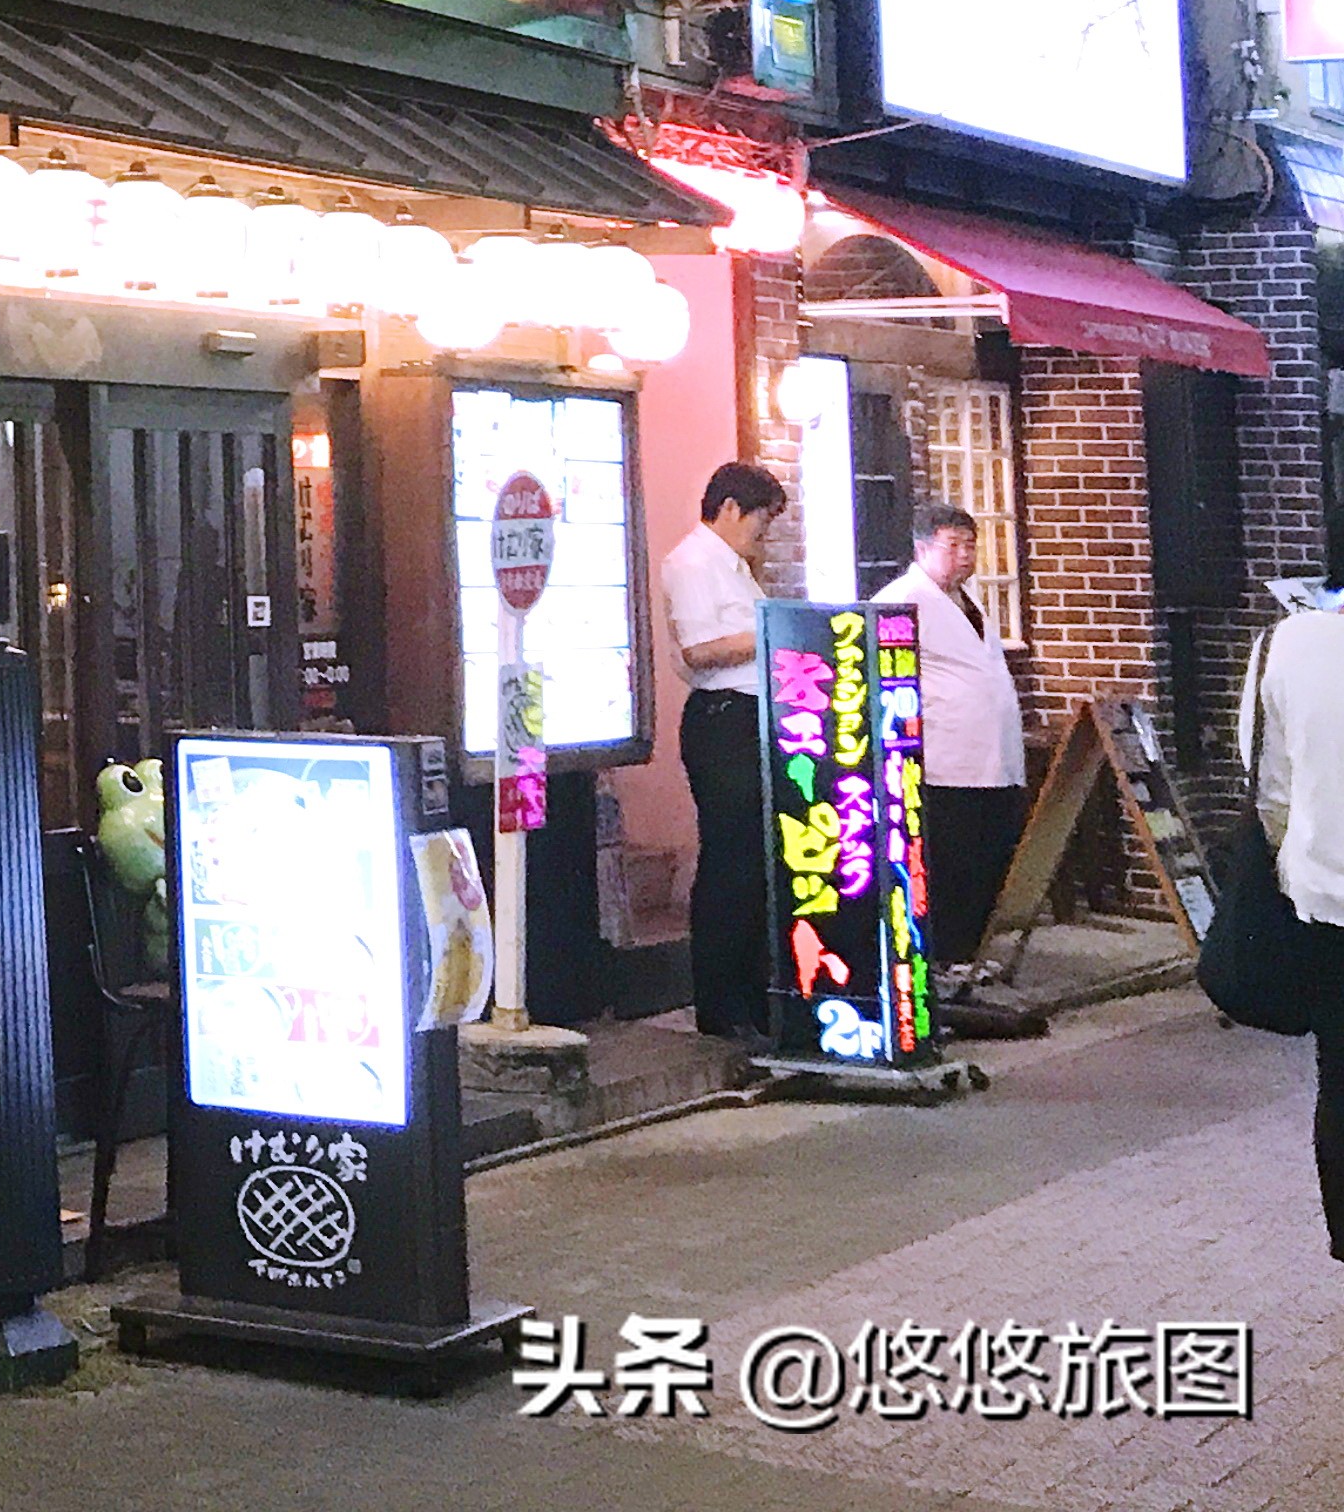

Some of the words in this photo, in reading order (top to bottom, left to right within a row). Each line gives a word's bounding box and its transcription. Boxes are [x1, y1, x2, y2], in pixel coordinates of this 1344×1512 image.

[816, 999, 885, 1062] 2F
[230, 1129, 369, 1182] けむり家
